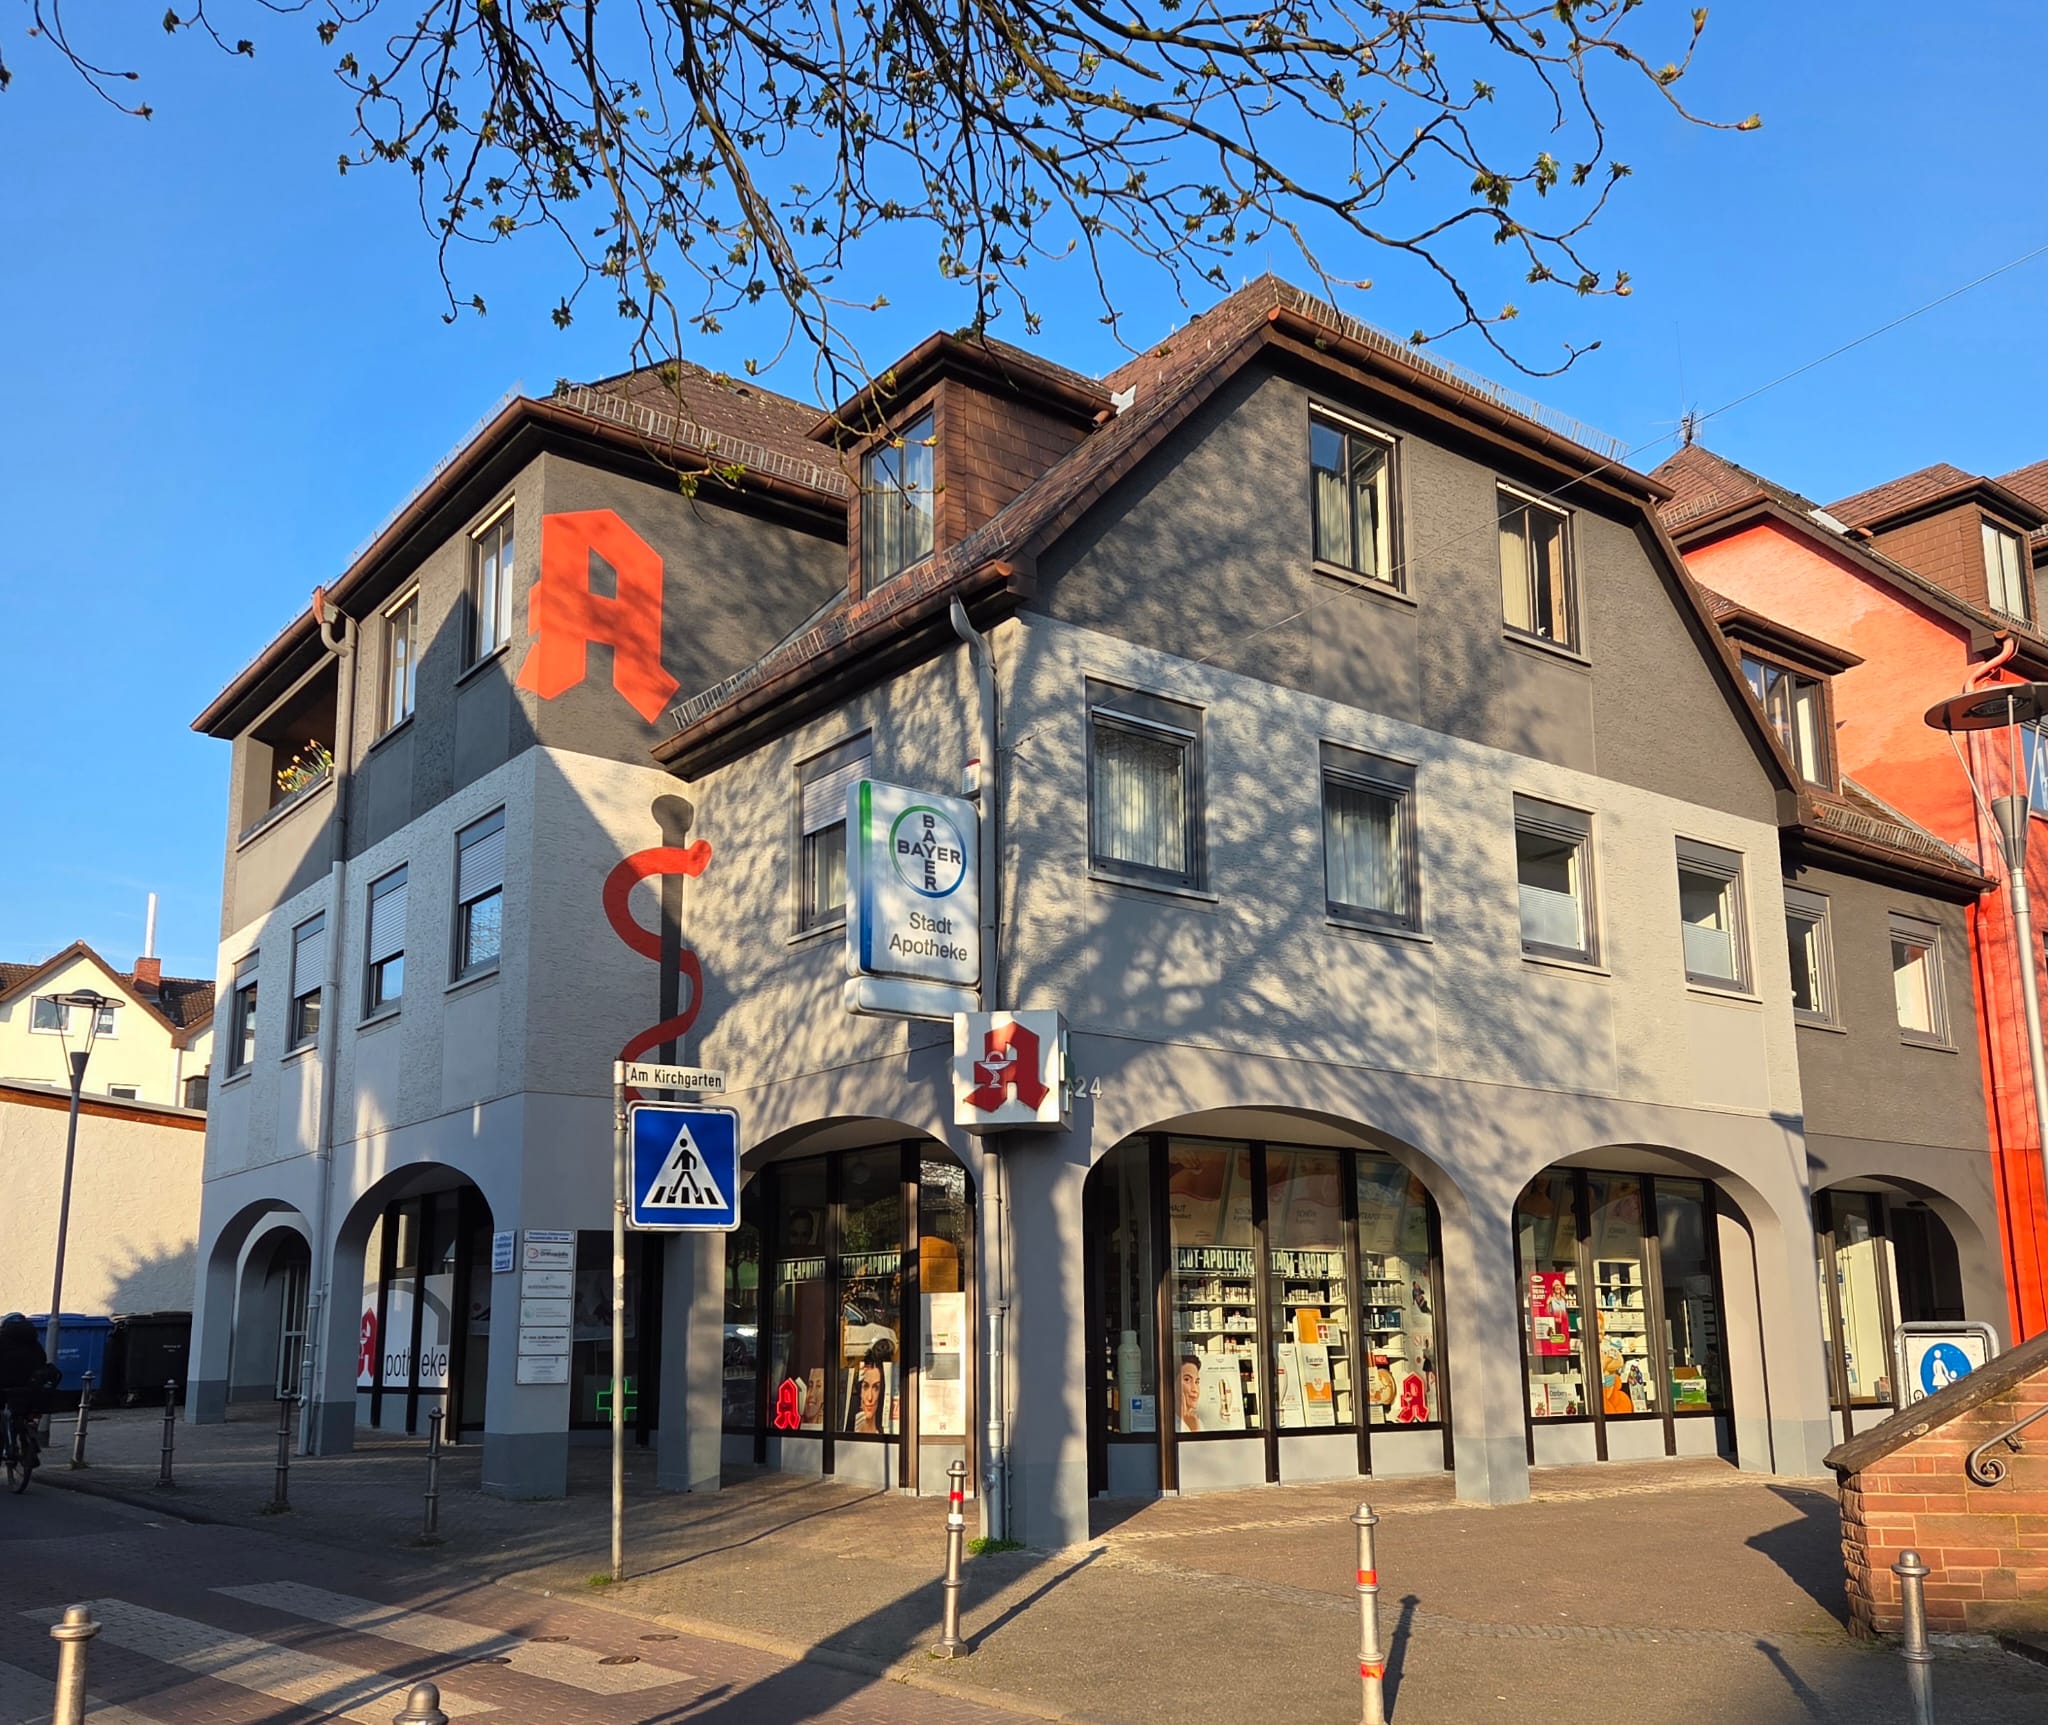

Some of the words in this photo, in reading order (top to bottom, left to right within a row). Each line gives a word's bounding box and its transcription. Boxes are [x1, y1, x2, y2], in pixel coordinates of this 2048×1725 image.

[897, 841, 961, 865] BAYER
[922, 814, 938, 891] BAYER
[909, 911, 952, 935] Stadt
[889, 933, 968, 961] Apotheke
[630, 1067, 649, 1083] Am
[654, 1069, 722, 1089] Kirchgarten
[1074, 1075, 1103, 1098] 24
